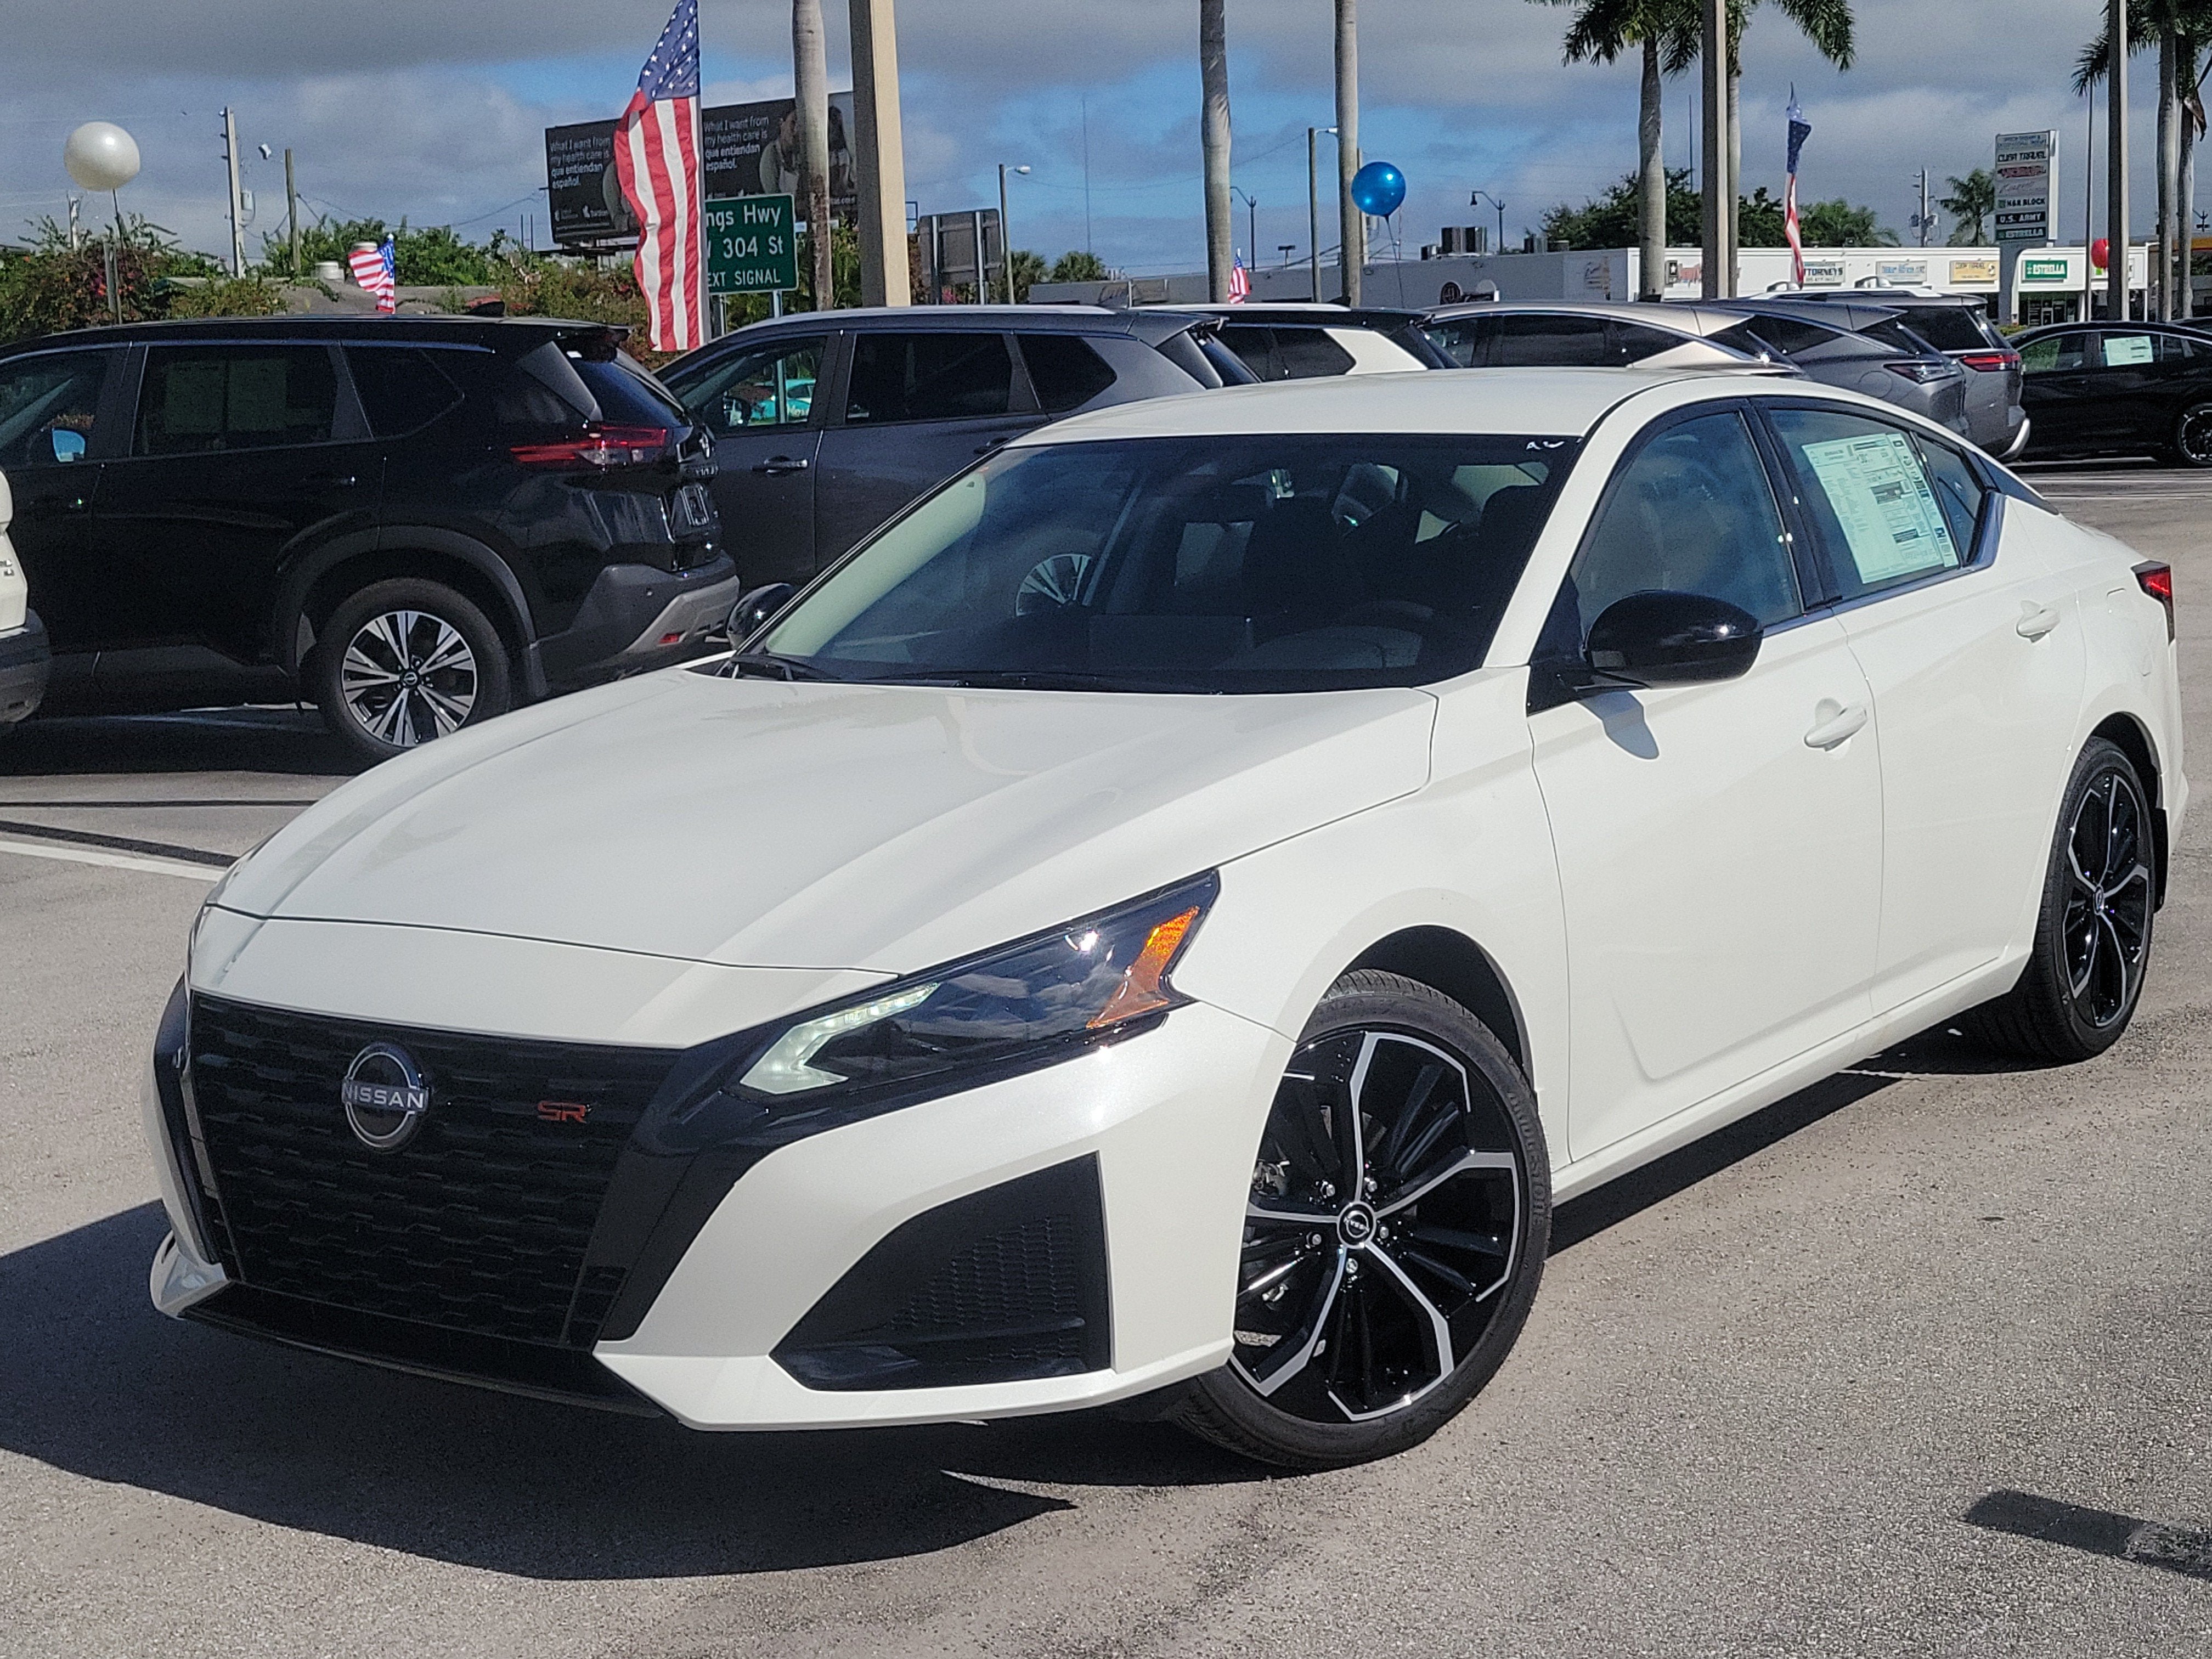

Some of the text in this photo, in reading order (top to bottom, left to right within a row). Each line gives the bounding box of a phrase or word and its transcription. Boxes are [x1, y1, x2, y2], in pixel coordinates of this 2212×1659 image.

[750, 116, 769, 127] from
[743, 131, 760, 141] care
[2023, 198, 2046, 206] BLOCK
[706, 204, 781, 232] ngs Hwy
[2019, 213, 2041, 222] ARMY
[723, 236, 758, 258] 304
[769, 235, 783, 254] St
[708, 268, 781, 287] EXT SIGNAL
[1803, 267, 1843, 275] TTORNEYS
[342, 1082, 424, 1109] NISSAN
[538, 1100, 587, 1124] SR
